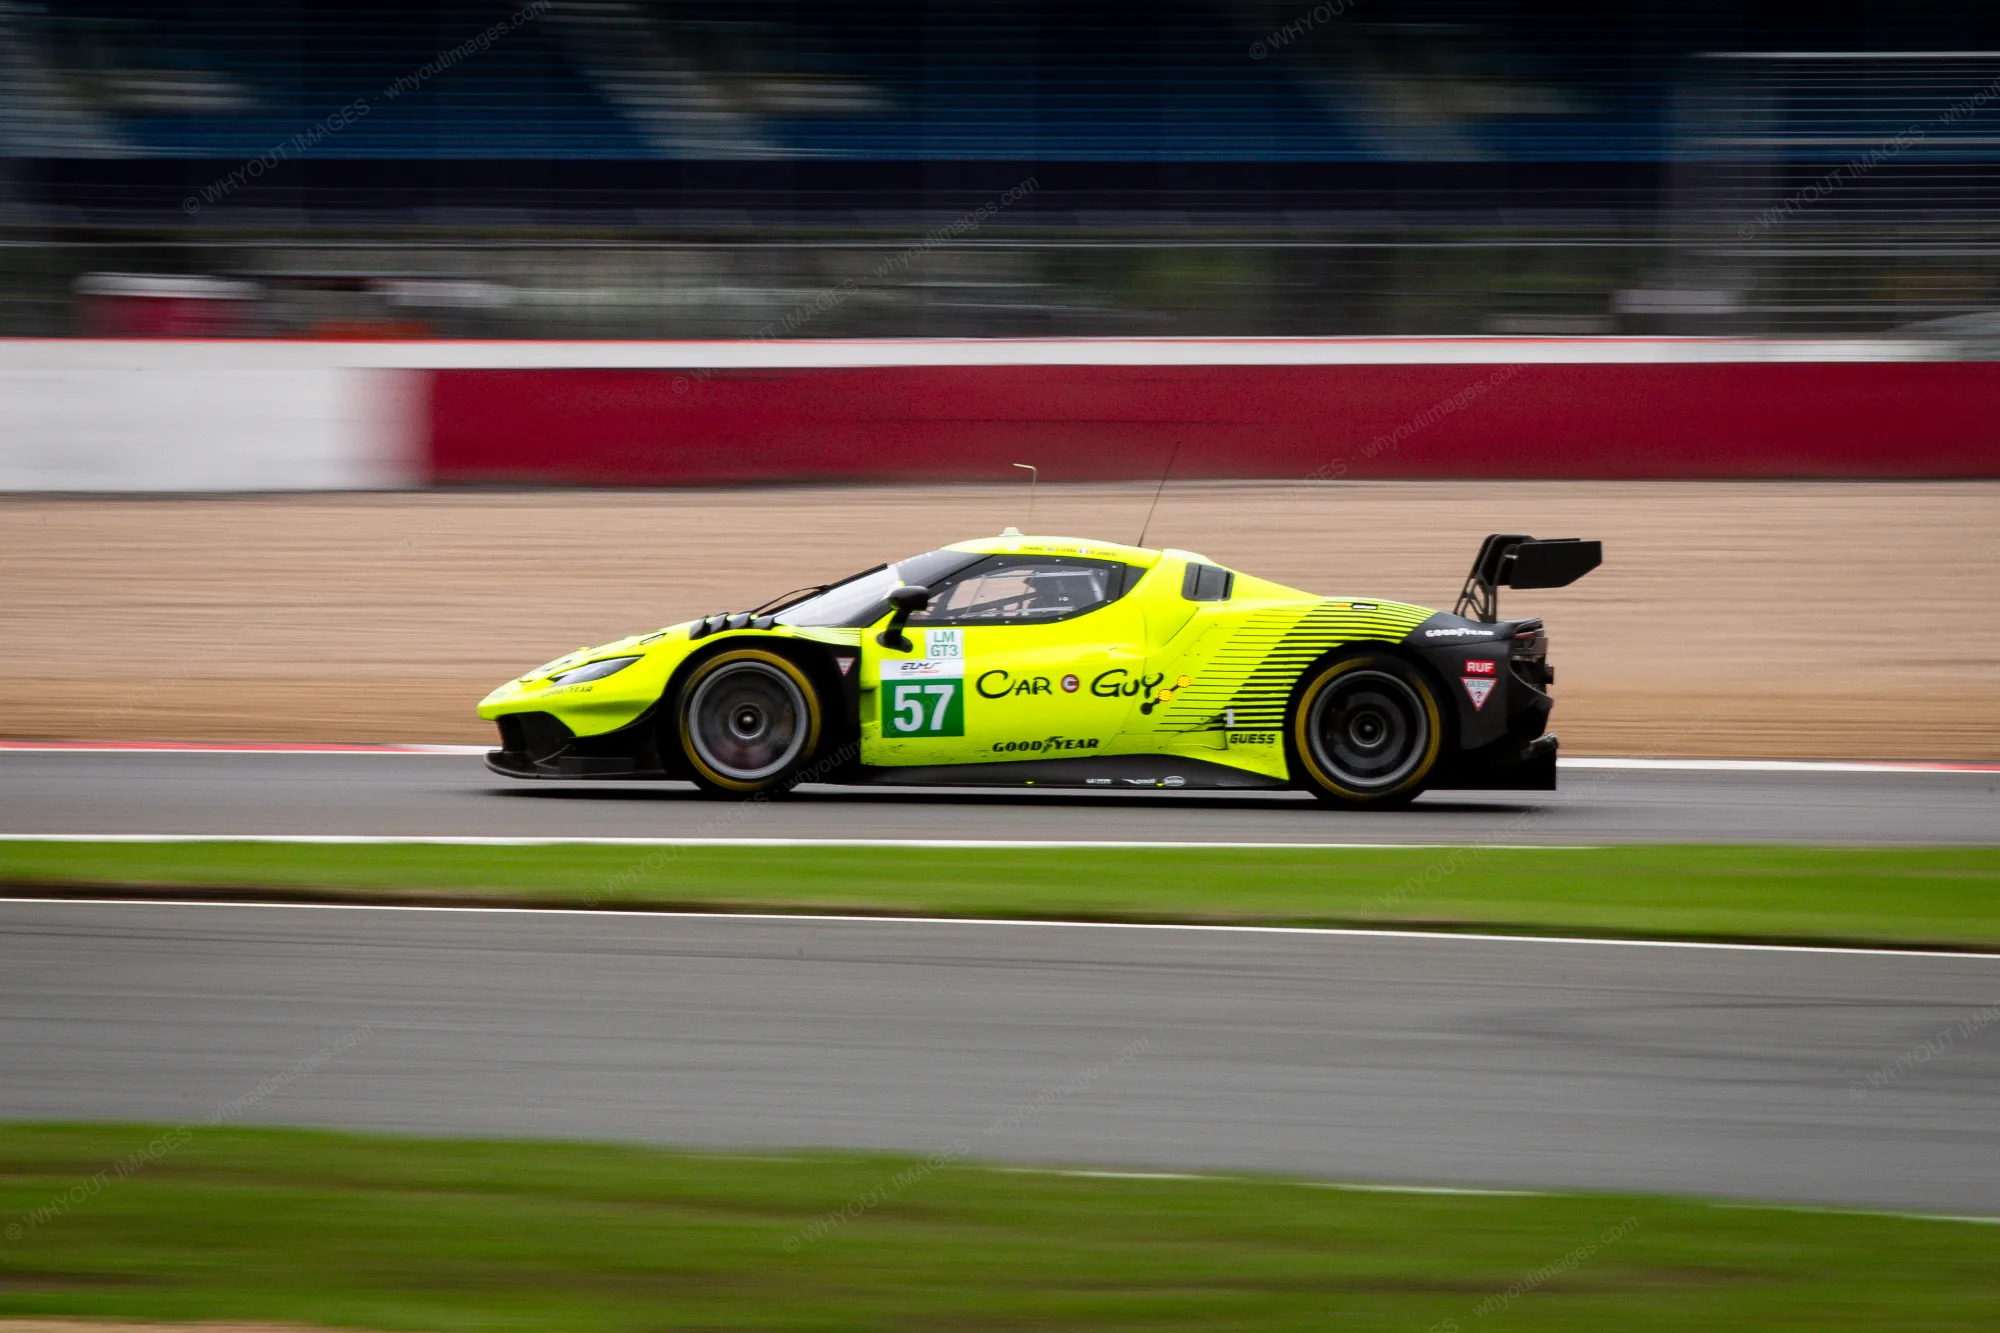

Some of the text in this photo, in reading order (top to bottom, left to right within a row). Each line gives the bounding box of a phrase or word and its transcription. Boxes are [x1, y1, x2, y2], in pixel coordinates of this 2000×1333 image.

[933, 631, 955, 643] LM
[930, 644, 958, 657] GT3
[1466, 661, 1494, 673] RUF
[893, 684, 955, 732] 57
[992, 735, 1099, 754] GOODYEAR
[1229, 733, 1276, 744] GUESS
